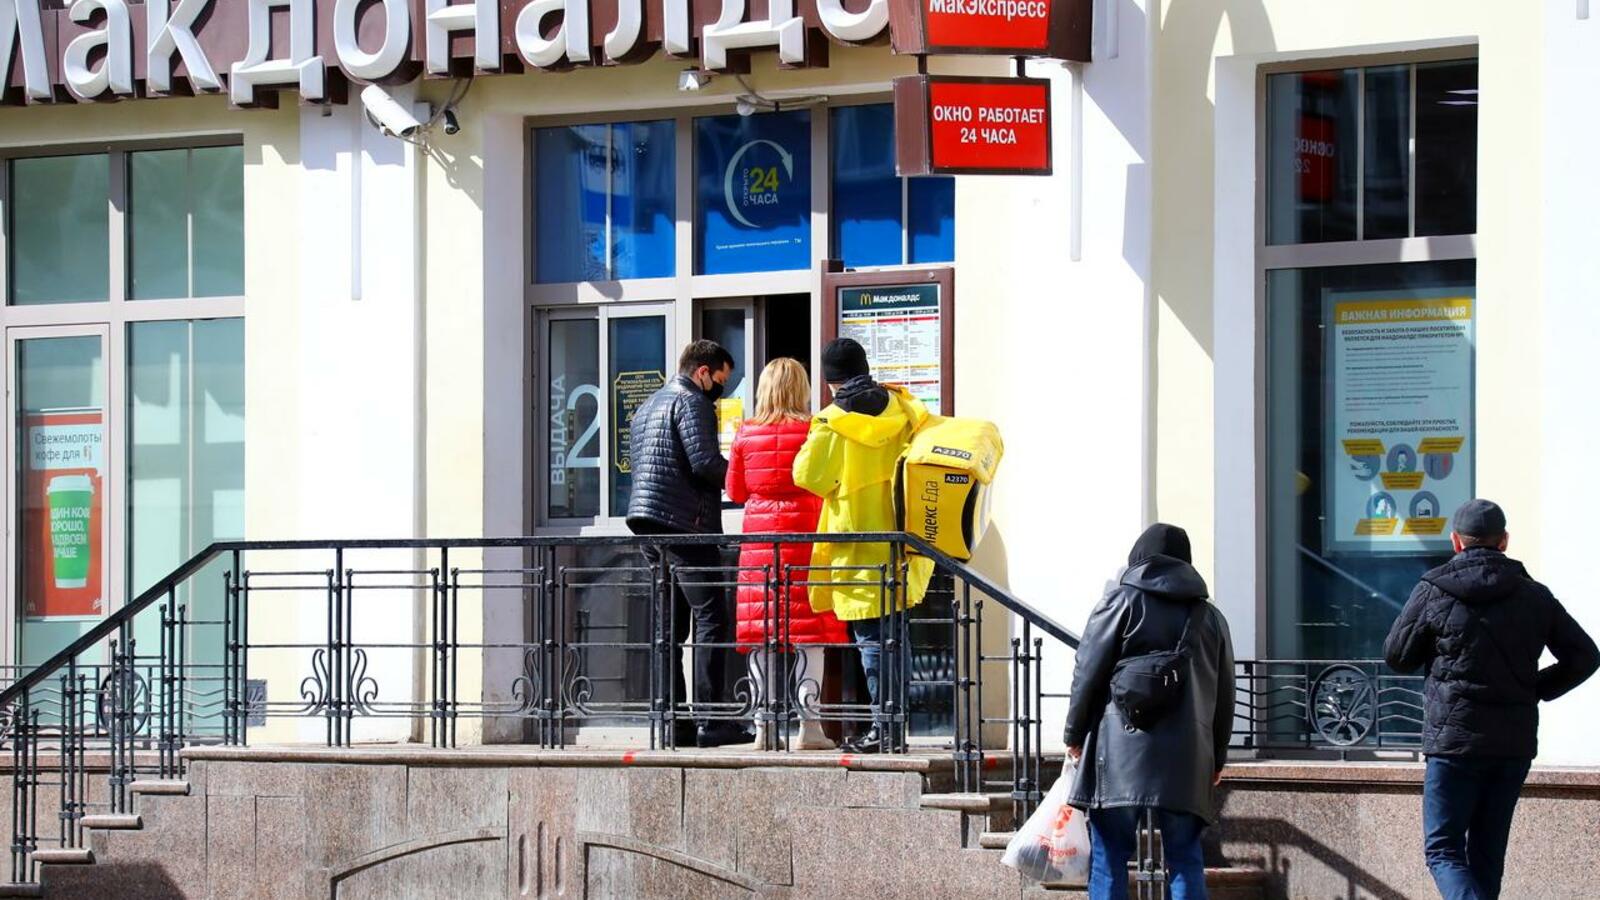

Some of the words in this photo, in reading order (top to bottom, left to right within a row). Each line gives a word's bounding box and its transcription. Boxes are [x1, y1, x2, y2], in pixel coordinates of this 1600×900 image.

[929, 0, 1046, 21] МакЭкспресс
[933, 105, 972, 122] ОКНО
[978, 107, 1045, 123] РАБОТАЕТ
[960, 127, 977, 143] 24
[980, 128, 1017, 144] ЧАСА
[749, 166, 779, 193] 24
[749, 193, 778, 205] ЧАСА
[873, 294, 921, 303] Макдоналдс
[1341, 309, 1388, 321] ВАЖНАЯ
[1389, 306, 1467, 319] ИНФОРМАЦИЯ
[551, 374, 568, 485] ВЫДАЧА
[566, 384, 600, 467] 2
[35, 448, 60, 464] кофе
[63, 450, 81, 463] для
[921, 480, 939, 503] Еда
